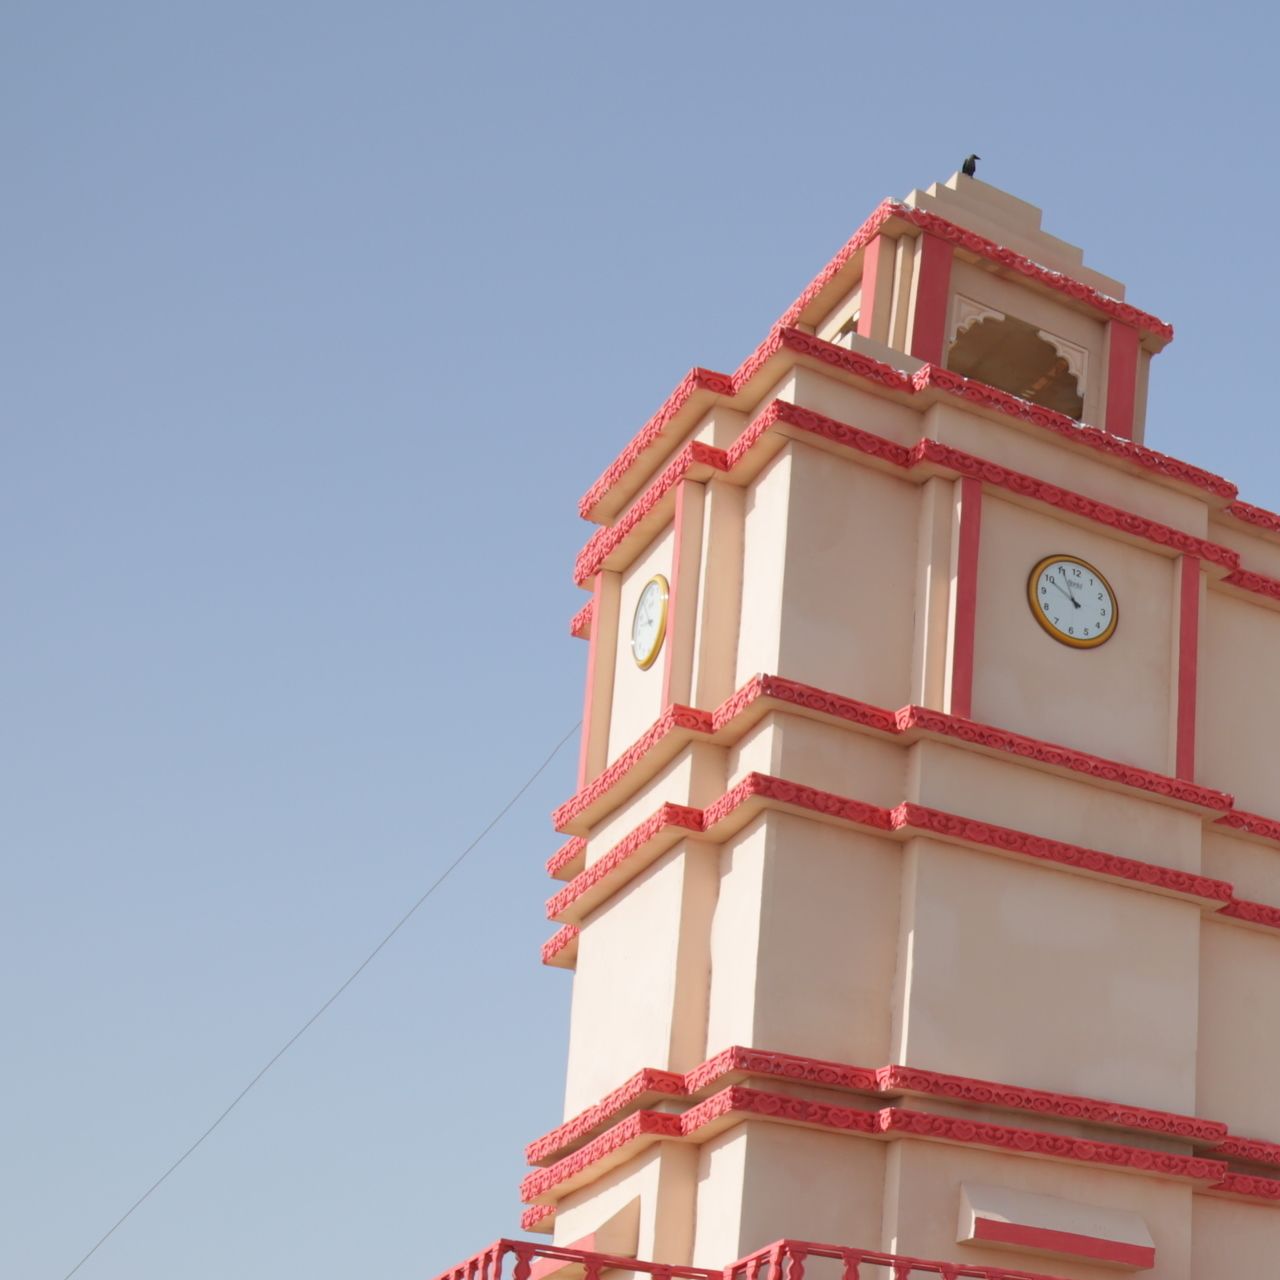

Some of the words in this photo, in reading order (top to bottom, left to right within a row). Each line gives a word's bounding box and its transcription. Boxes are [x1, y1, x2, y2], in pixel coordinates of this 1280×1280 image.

[1072, 568, 1082, 578] 12
[1045, 574, 1055, 584] 10
[1041, 586, 1047, 595] 9
[1097, 592, 1103, 600] 2
[1043, 602, 1049, 611] 8
[1100, 608, 1106, 616] 3
[1053, 616, 1060, 624] 7
[1095, 621, 1101, 629] 4
[1068, 626, 1074, 635] 6
[1083, 628, 1089, 636] 5
